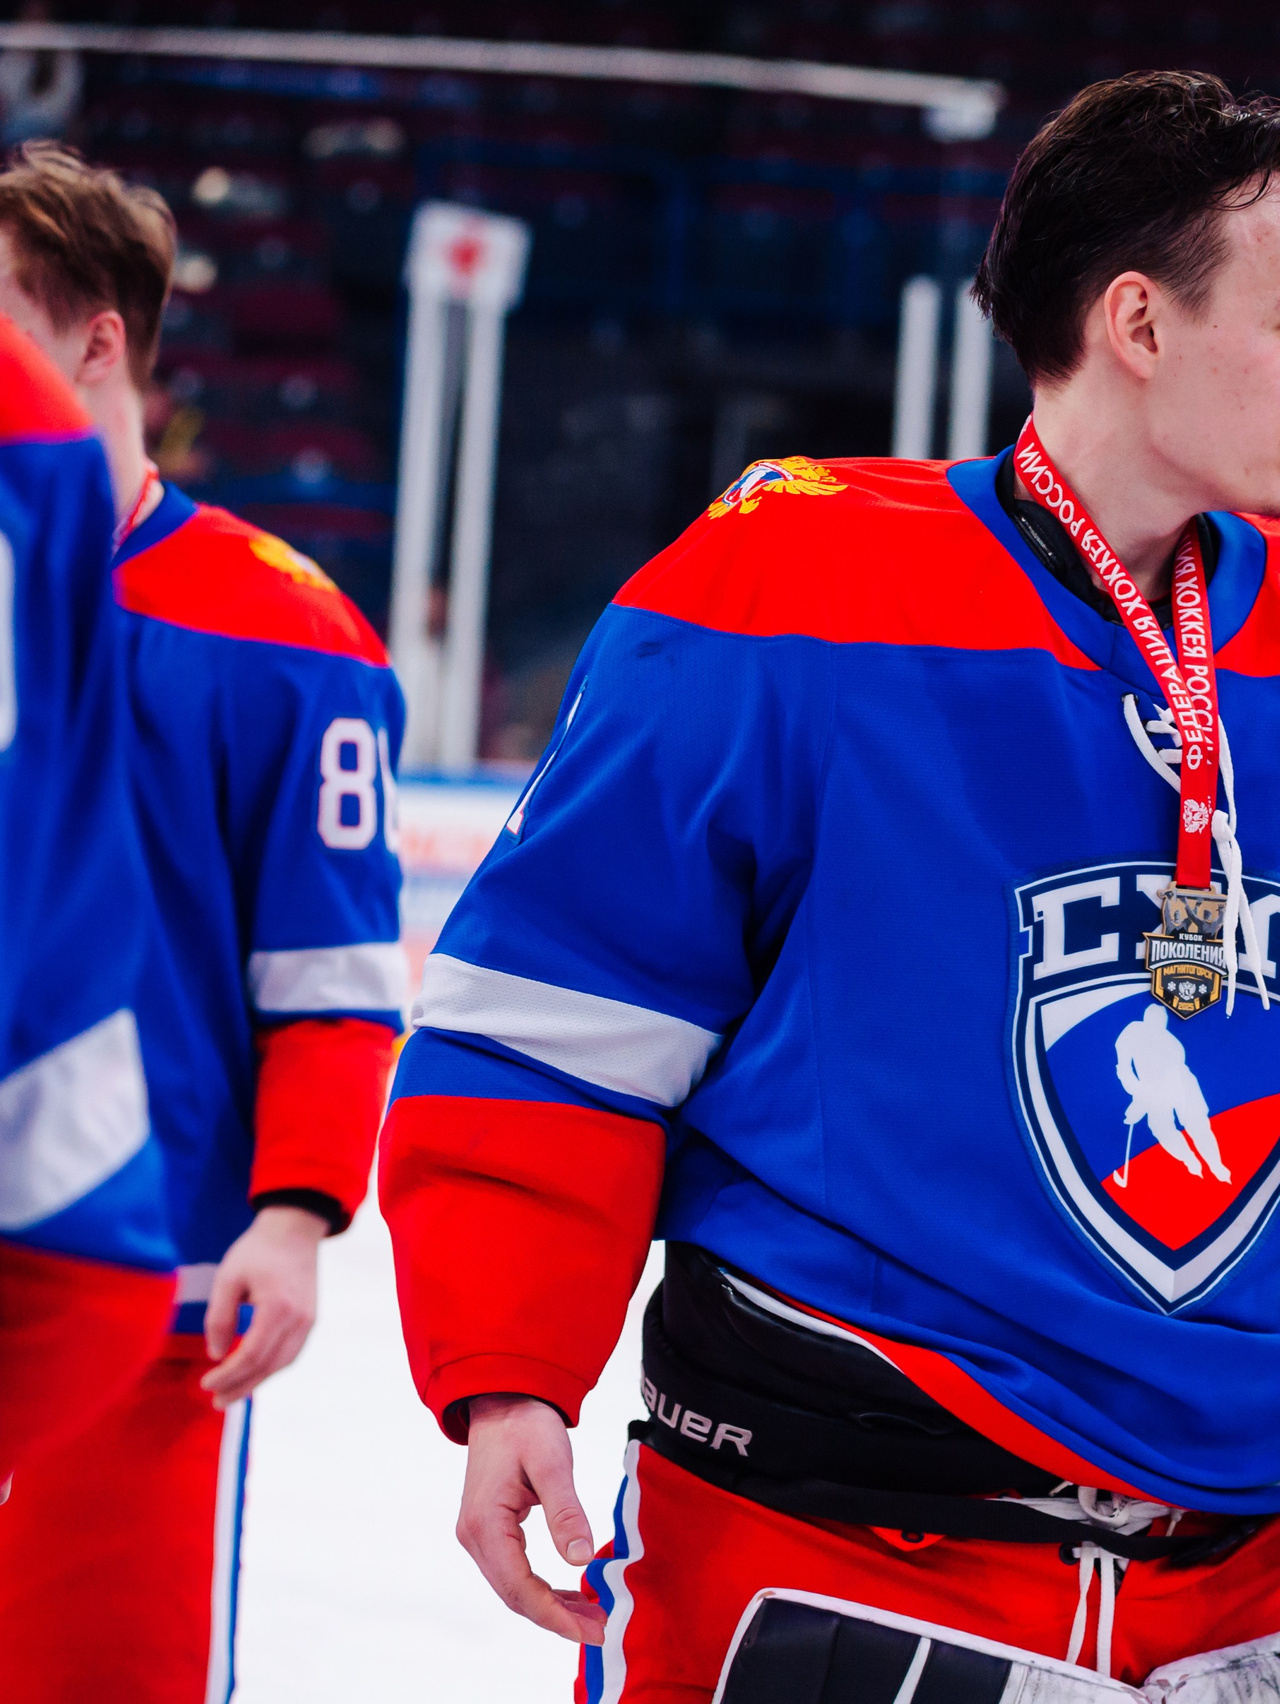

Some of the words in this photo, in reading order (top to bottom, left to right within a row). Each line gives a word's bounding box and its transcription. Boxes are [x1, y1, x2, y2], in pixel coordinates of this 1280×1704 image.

[1016, 442, 1086, 537] РОССИИ
[1081, 528, 1148, 617] ХОККЕЯ
[1175, 576, 1208, 659] ХОККЕЯ
[1132, 615, 1204, 770] ФЕДЕРАЦИЯ
[1163, 964, 1213, 979] МАГНИТОГОРСК
[1179, 933, 1203, 941] КУБОК
